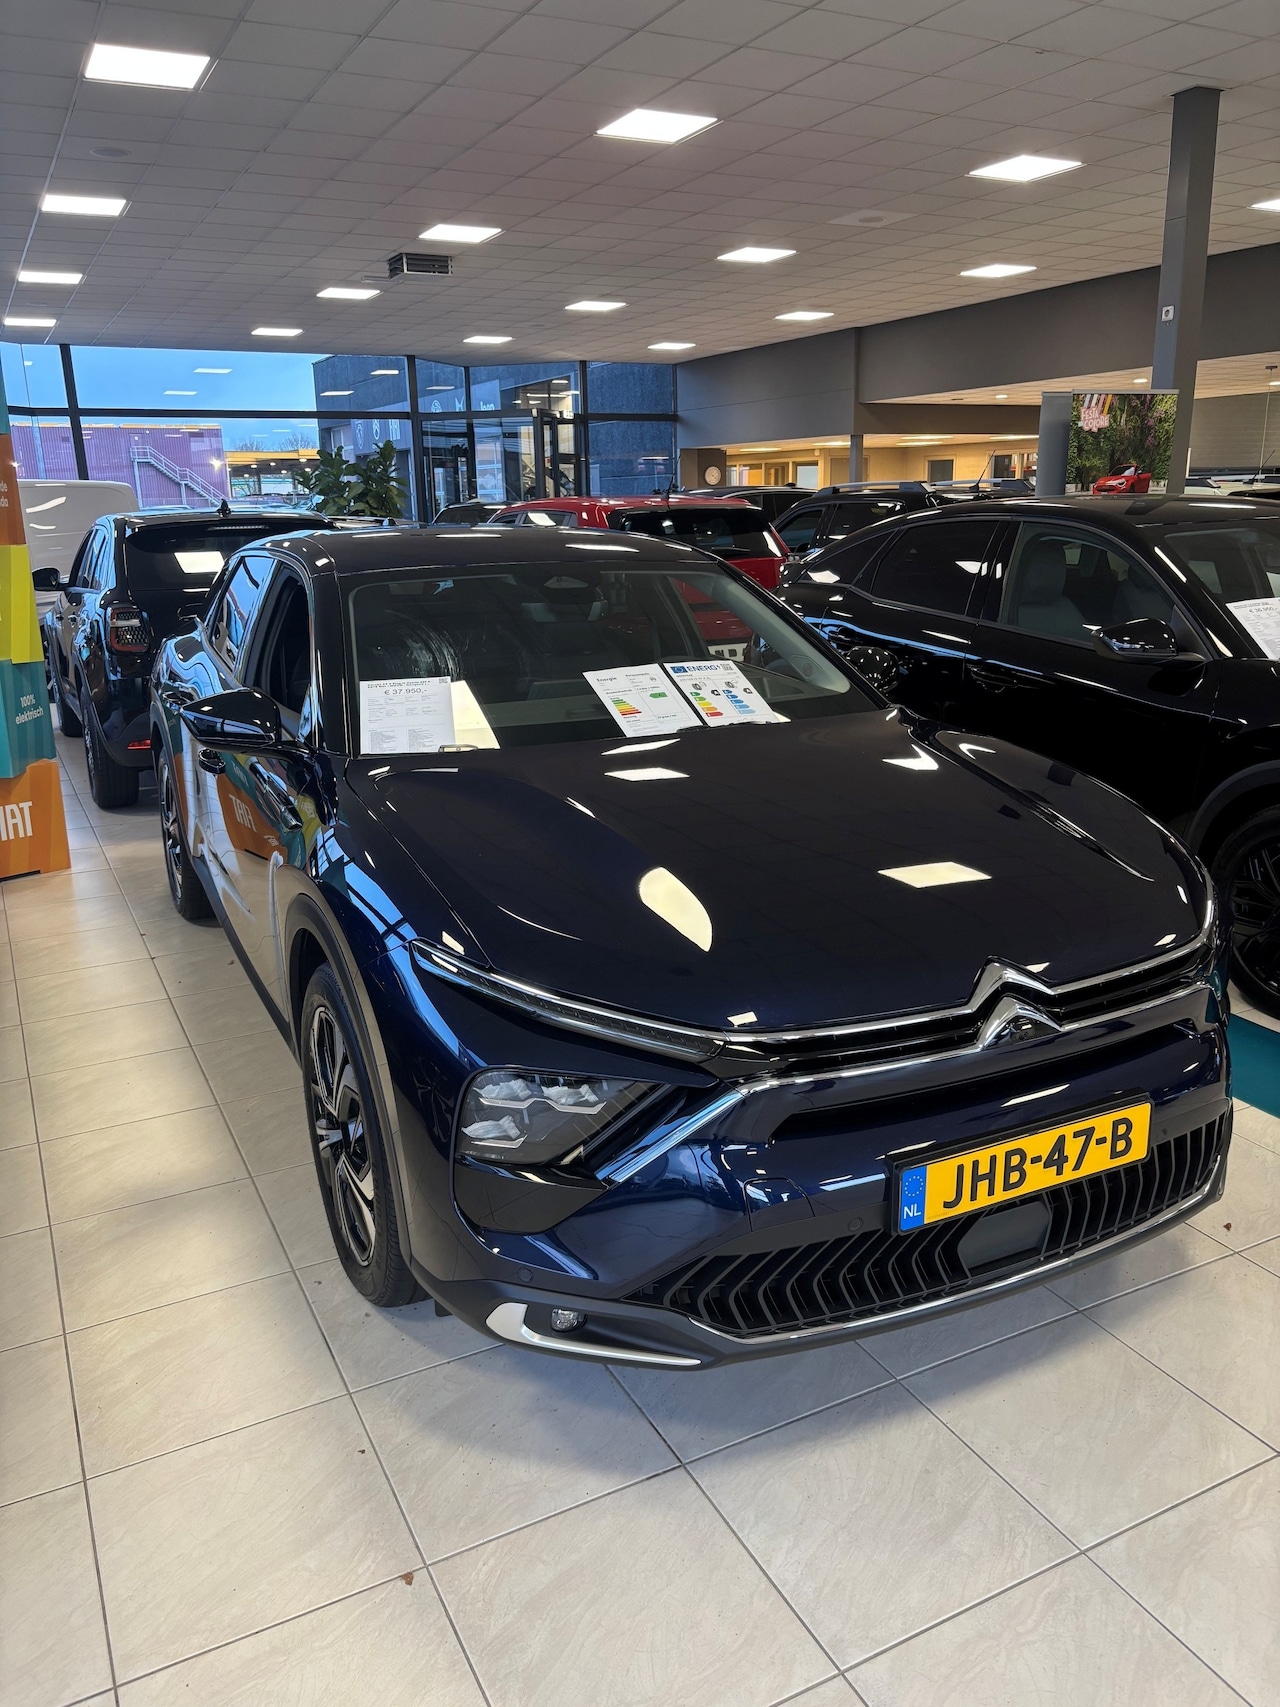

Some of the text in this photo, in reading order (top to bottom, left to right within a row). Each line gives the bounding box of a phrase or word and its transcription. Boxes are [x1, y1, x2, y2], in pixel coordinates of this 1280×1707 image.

[1081, 408, 1099, 420] FESTA
[20, 694, 36, 708] 100%
[15, 706, 44, 725] elektrisch
[0, 801, 34, 842] IAT
[942, 1117, 1134, 1210] JHB-47-B
[903, 1203, 922, 1220] NL
